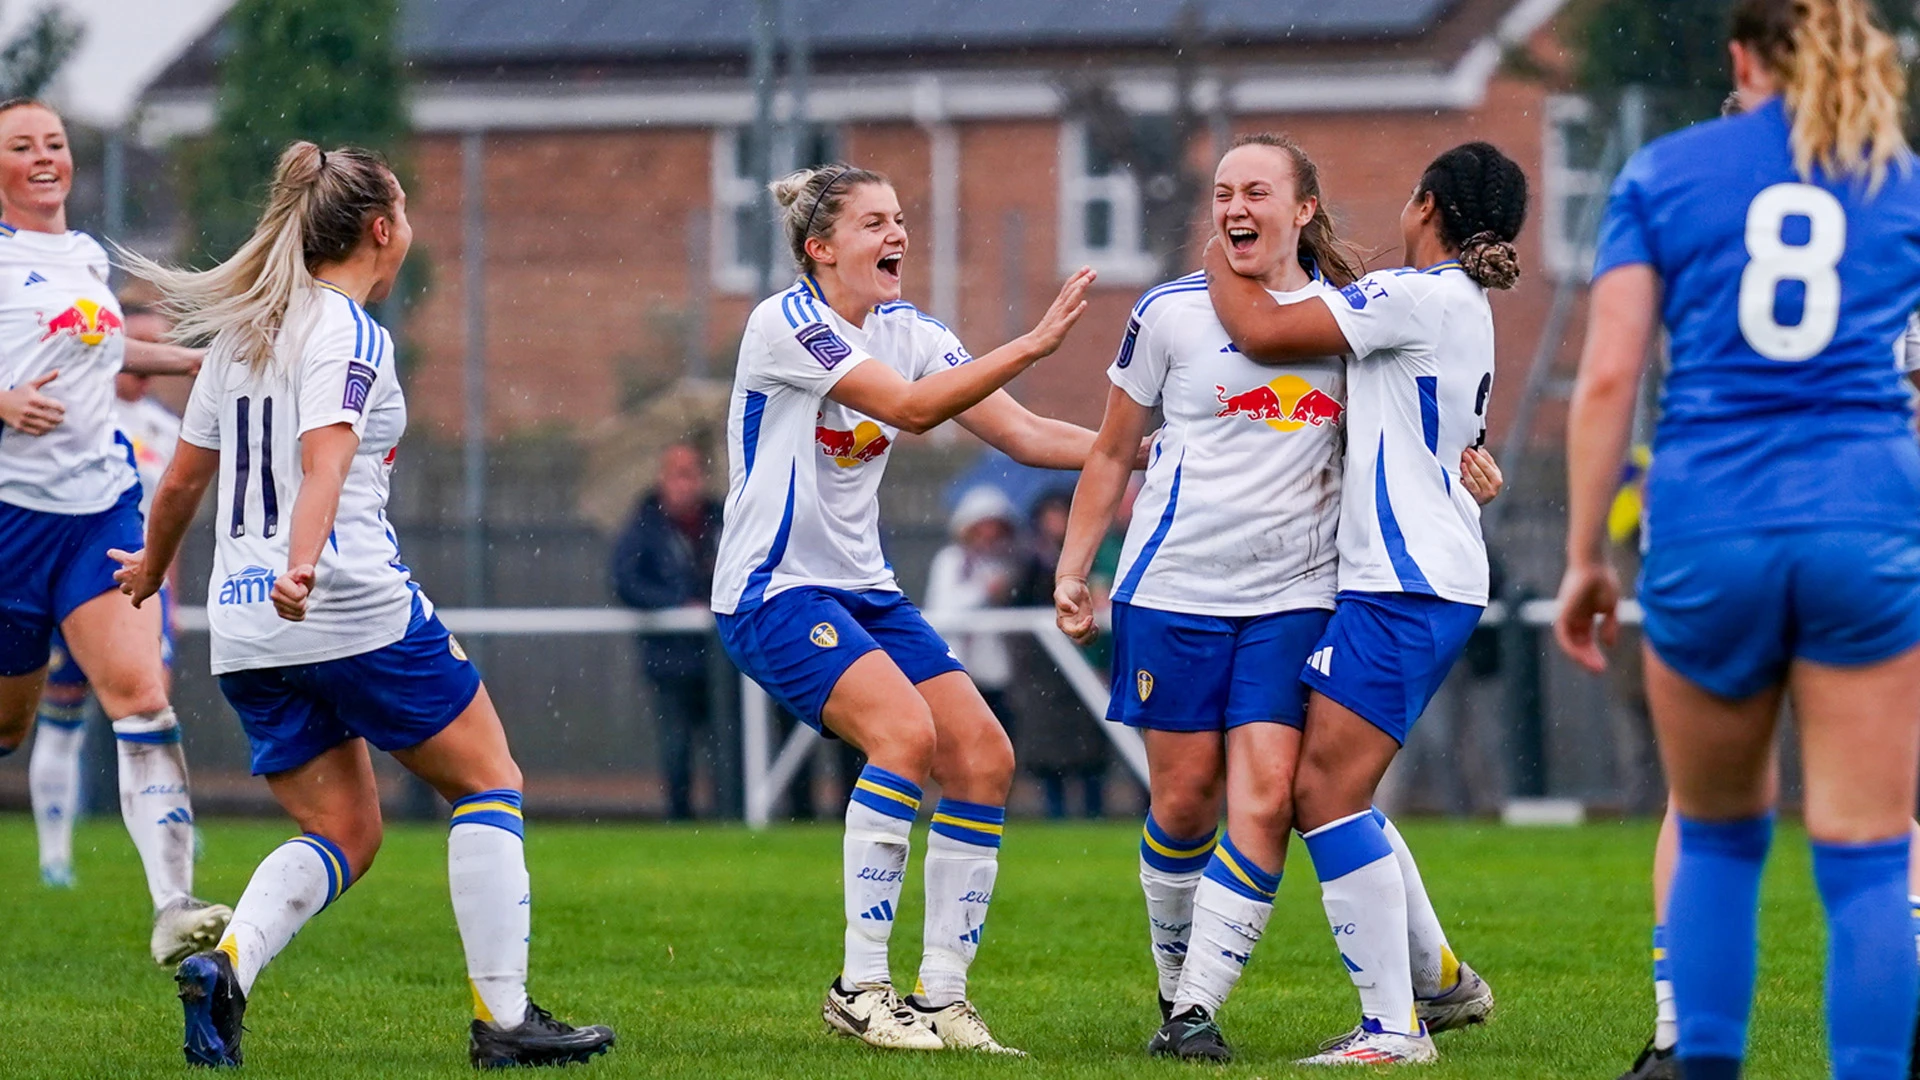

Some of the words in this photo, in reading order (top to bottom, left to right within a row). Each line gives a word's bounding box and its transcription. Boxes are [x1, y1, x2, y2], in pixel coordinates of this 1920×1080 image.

[1360, 277, 1389, 299] XT
[1737, 181, 1847, 362] 8
[230, 395, 278, 539] 11
[219, 568, 277, 605] amt
